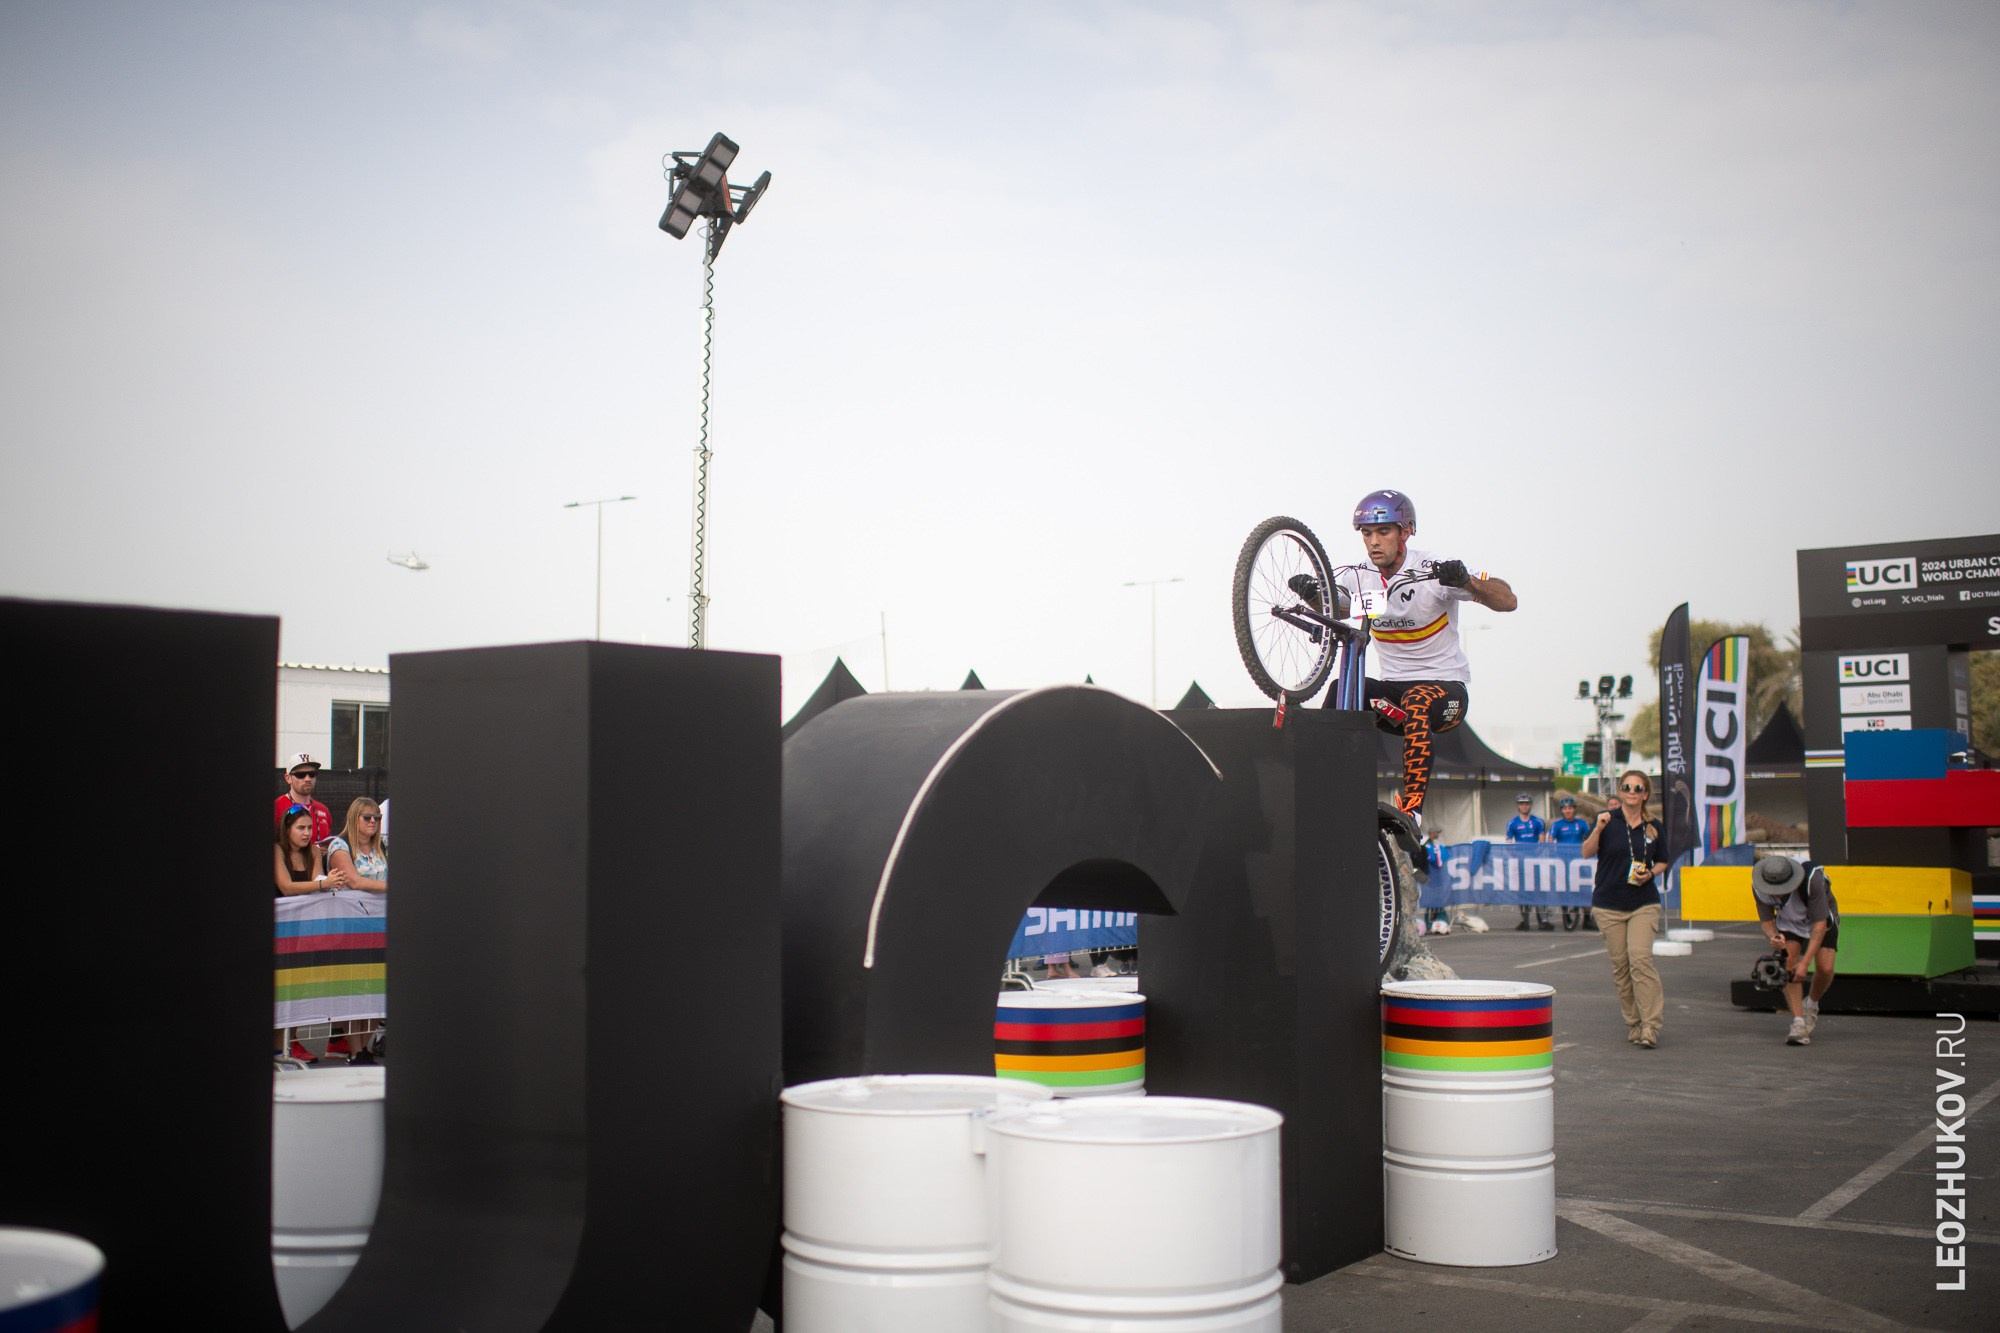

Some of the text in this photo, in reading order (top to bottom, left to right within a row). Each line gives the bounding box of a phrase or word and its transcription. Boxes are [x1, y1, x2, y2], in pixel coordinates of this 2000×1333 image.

[1922, 561, 1946, 571] 2024
[1949, 557, 1987, 569] URBAN
[1858, 563, 1911, 586] UCI
[1922, 571, 1963, 582] WORLD
[1911, 594, 1945, 604] UCI_Trials
[1372, 618, 1415, 628] Cofidis
[1854, 659, 1899, 677] UCI
[1883, 690, 1903, 698] Dhabi
[1705, 689, 1738, 798] UCI
[1447, 857, 1673, 892] SHIMA
